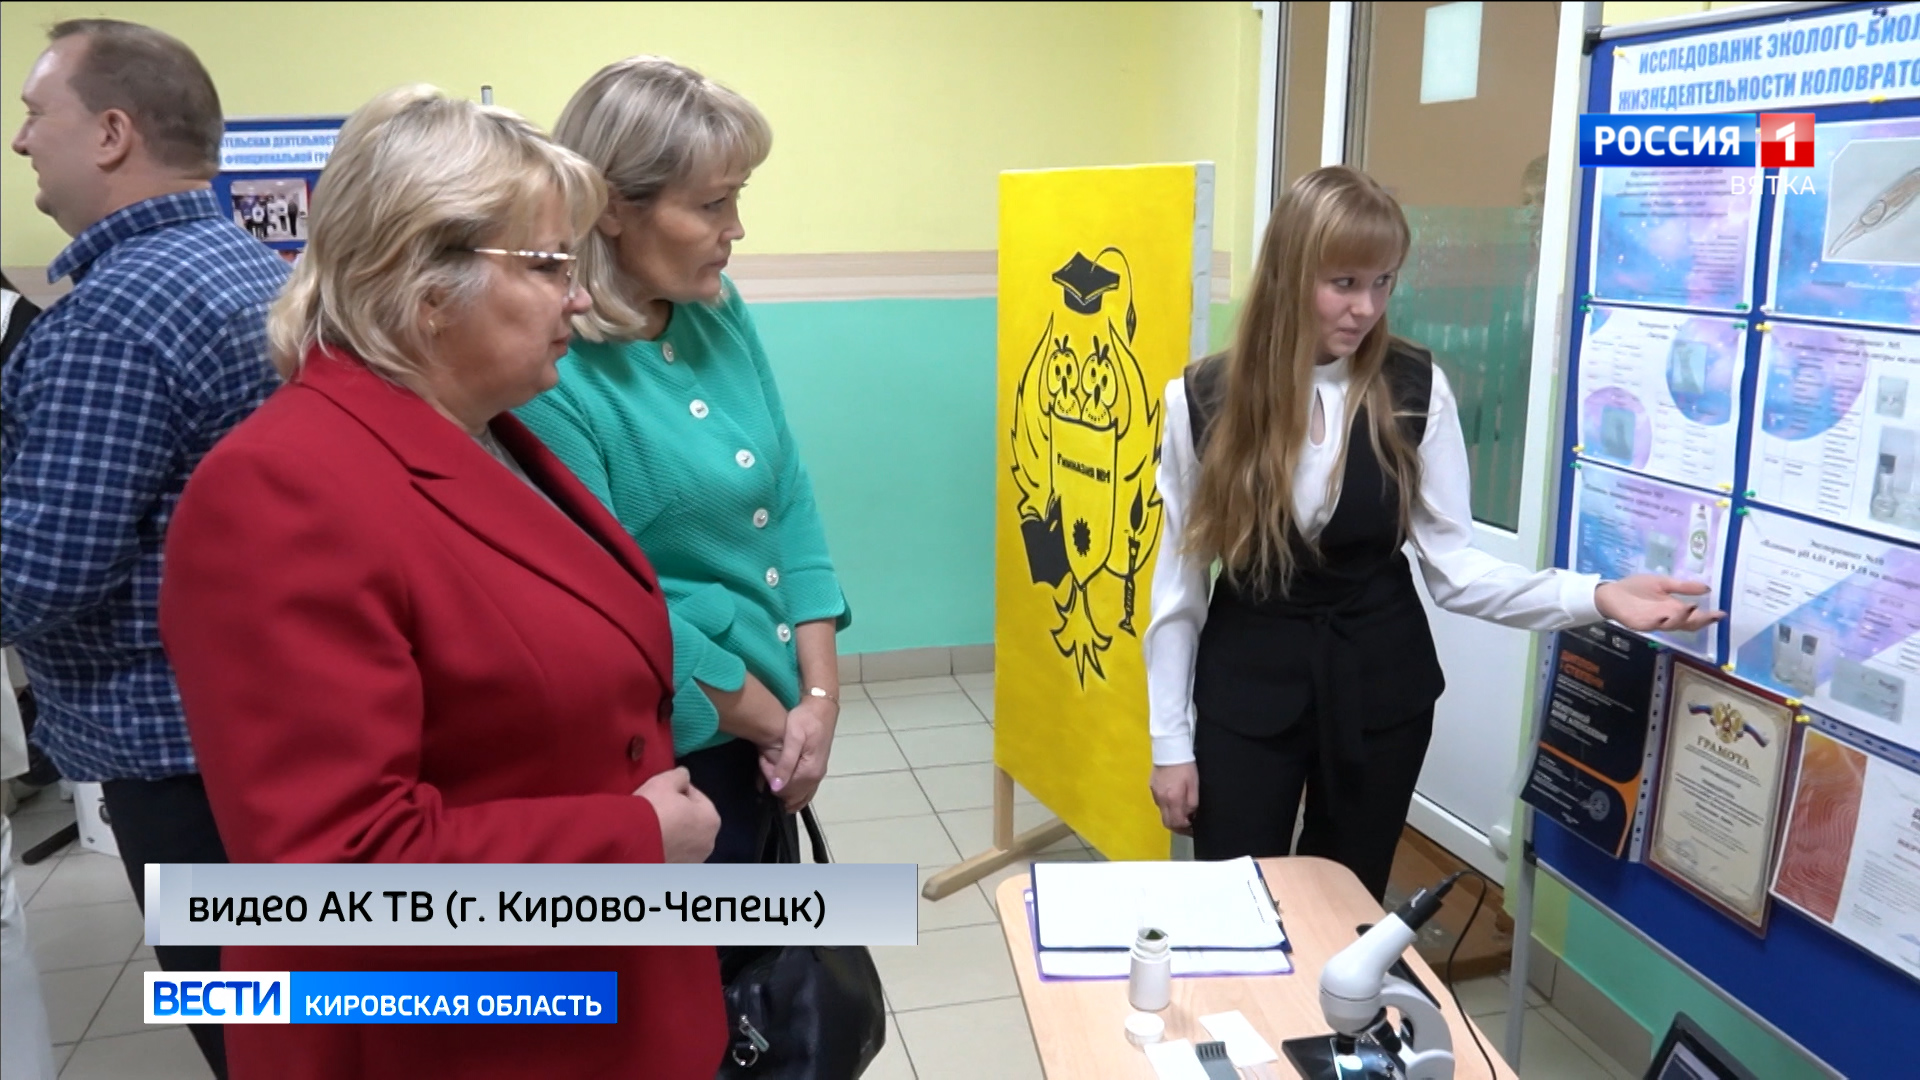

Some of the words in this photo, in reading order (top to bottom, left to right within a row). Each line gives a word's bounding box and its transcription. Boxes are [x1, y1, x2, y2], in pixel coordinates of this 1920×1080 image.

[1638, 36, 1763, 75] ИССЛЕДОВАНИЕ
[1618, 72, 1797, 112] ЖИЗНЕДЕЯТЕЛЬНОСТИ
[1800, 57, 1920, 96] КОЛОВРАТО
[1696, 735, 1750, 770] ГРАМОТА
